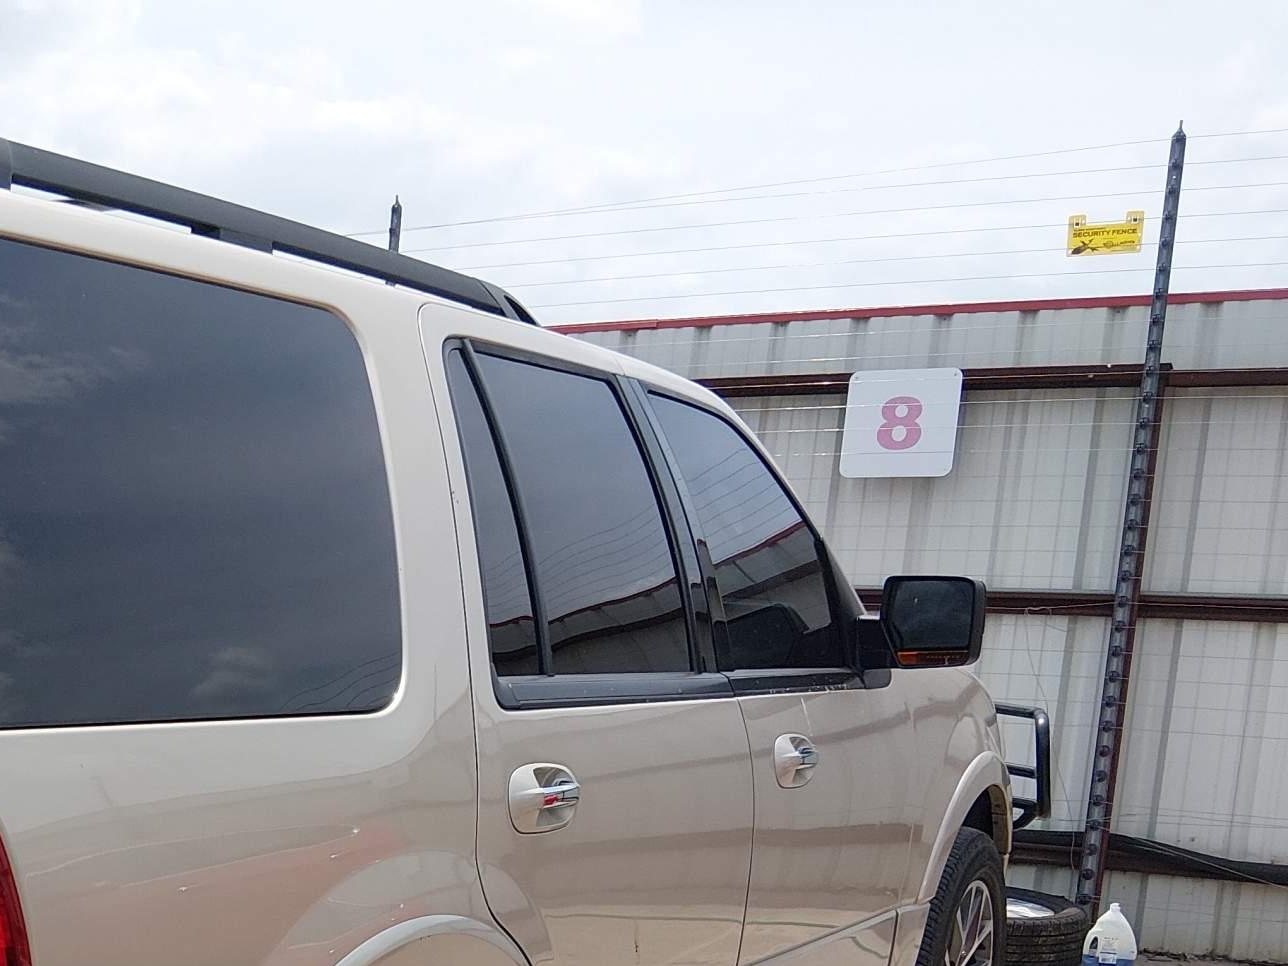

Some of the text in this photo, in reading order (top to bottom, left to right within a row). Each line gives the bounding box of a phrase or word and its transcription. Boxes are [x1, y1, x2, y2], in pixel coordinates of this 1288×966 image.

[1072, 230, 1111, 238] SECURITY
[1112, 228, 1137, 236] FENCE
[876, 396, 923, 451] 8
